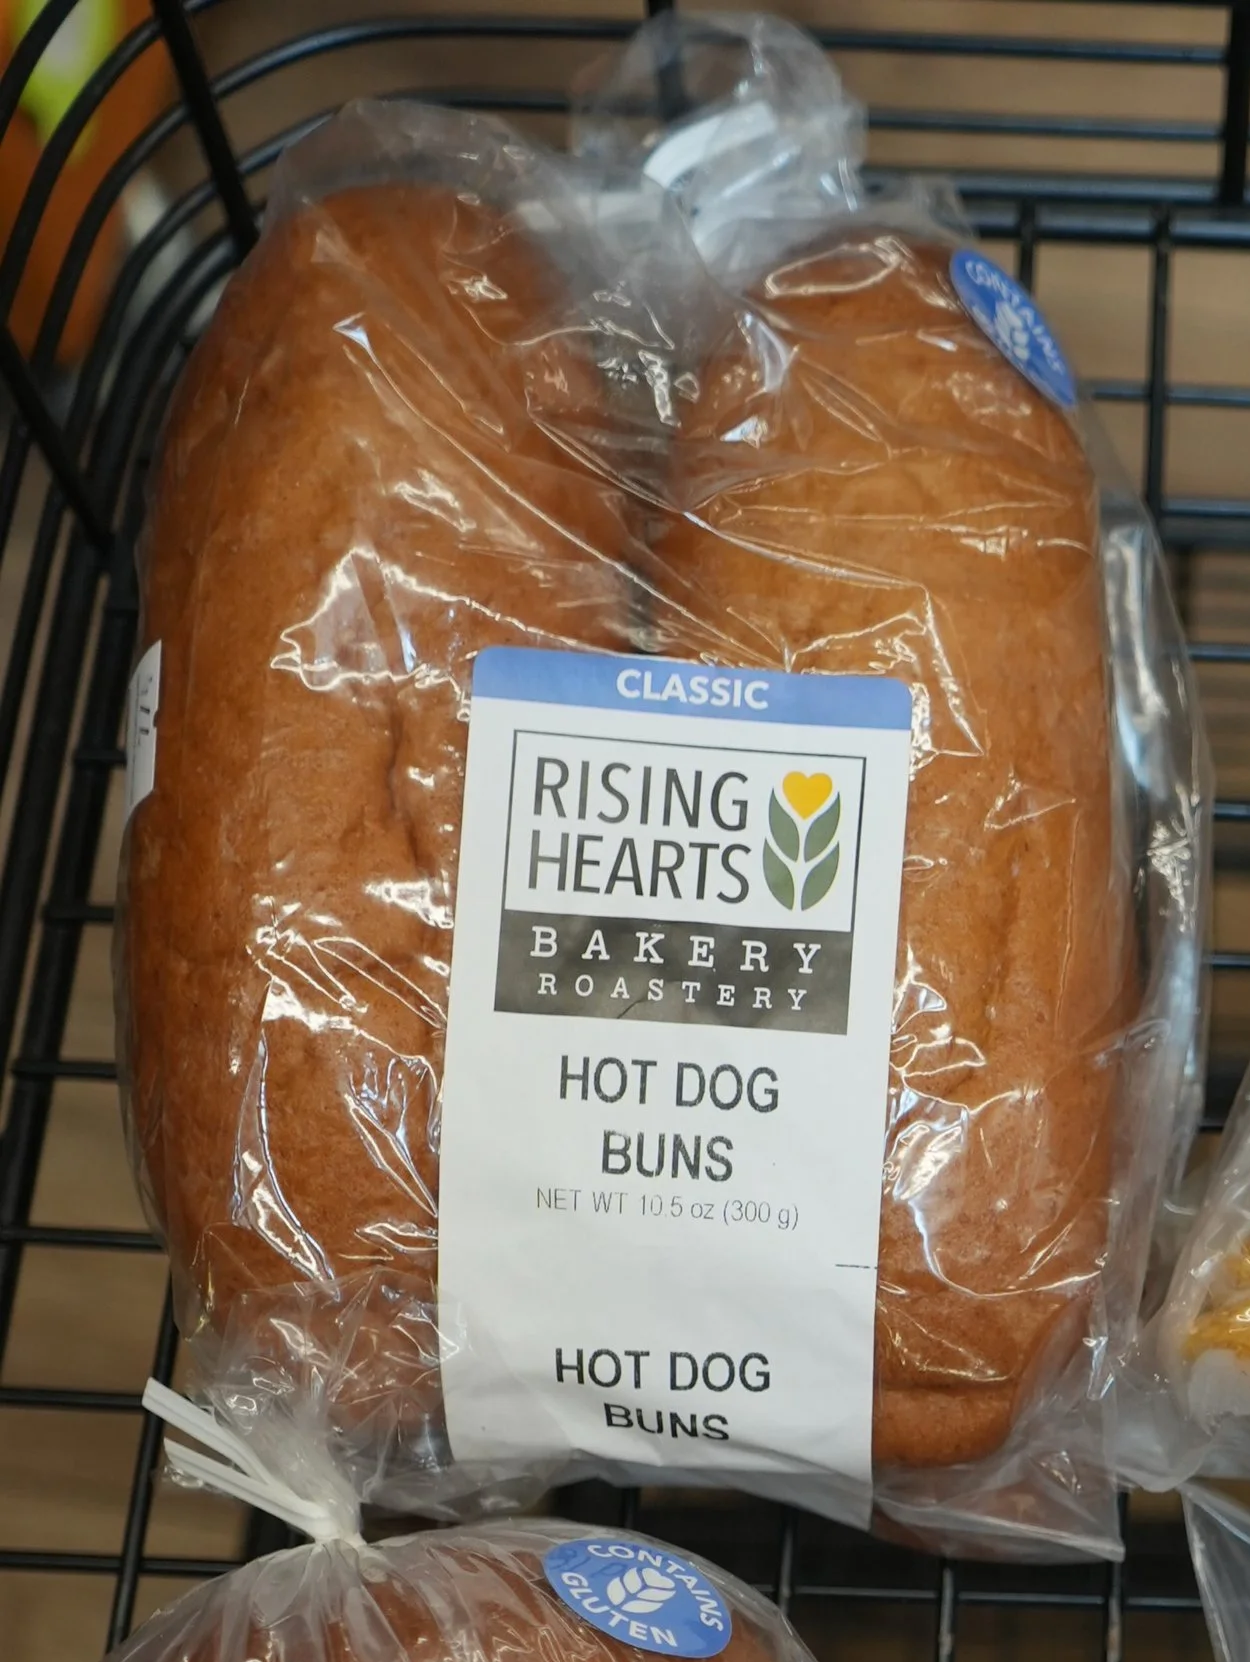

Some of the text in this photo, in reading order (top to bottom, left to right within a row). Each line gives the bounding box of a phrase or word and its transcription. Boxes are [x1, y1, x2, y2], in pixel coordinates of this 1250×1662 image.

[616, 668, 770, 710] CLASSIC
[532, 756, 749, 831] RISING
[527, 830, 752, 904] HEARTS
[530, 926, 821, 974] BAKERY
[538, 973, 807, 1010] ROASTERY
[559, 1055, 779, 1113] HOT DOG
[600, 1130, 734, 1181] BUNS
[537, 1187, 800, 1231] NET WT 10.5 oz (300 g)
[555, 1347, 772, 1393] HOT DOG
[602, 1402, 731, 1442] BUNS
[561, 1571, 678, 1647] GLUTEN
[587, 1544, 724, 1632] CONTAINS
